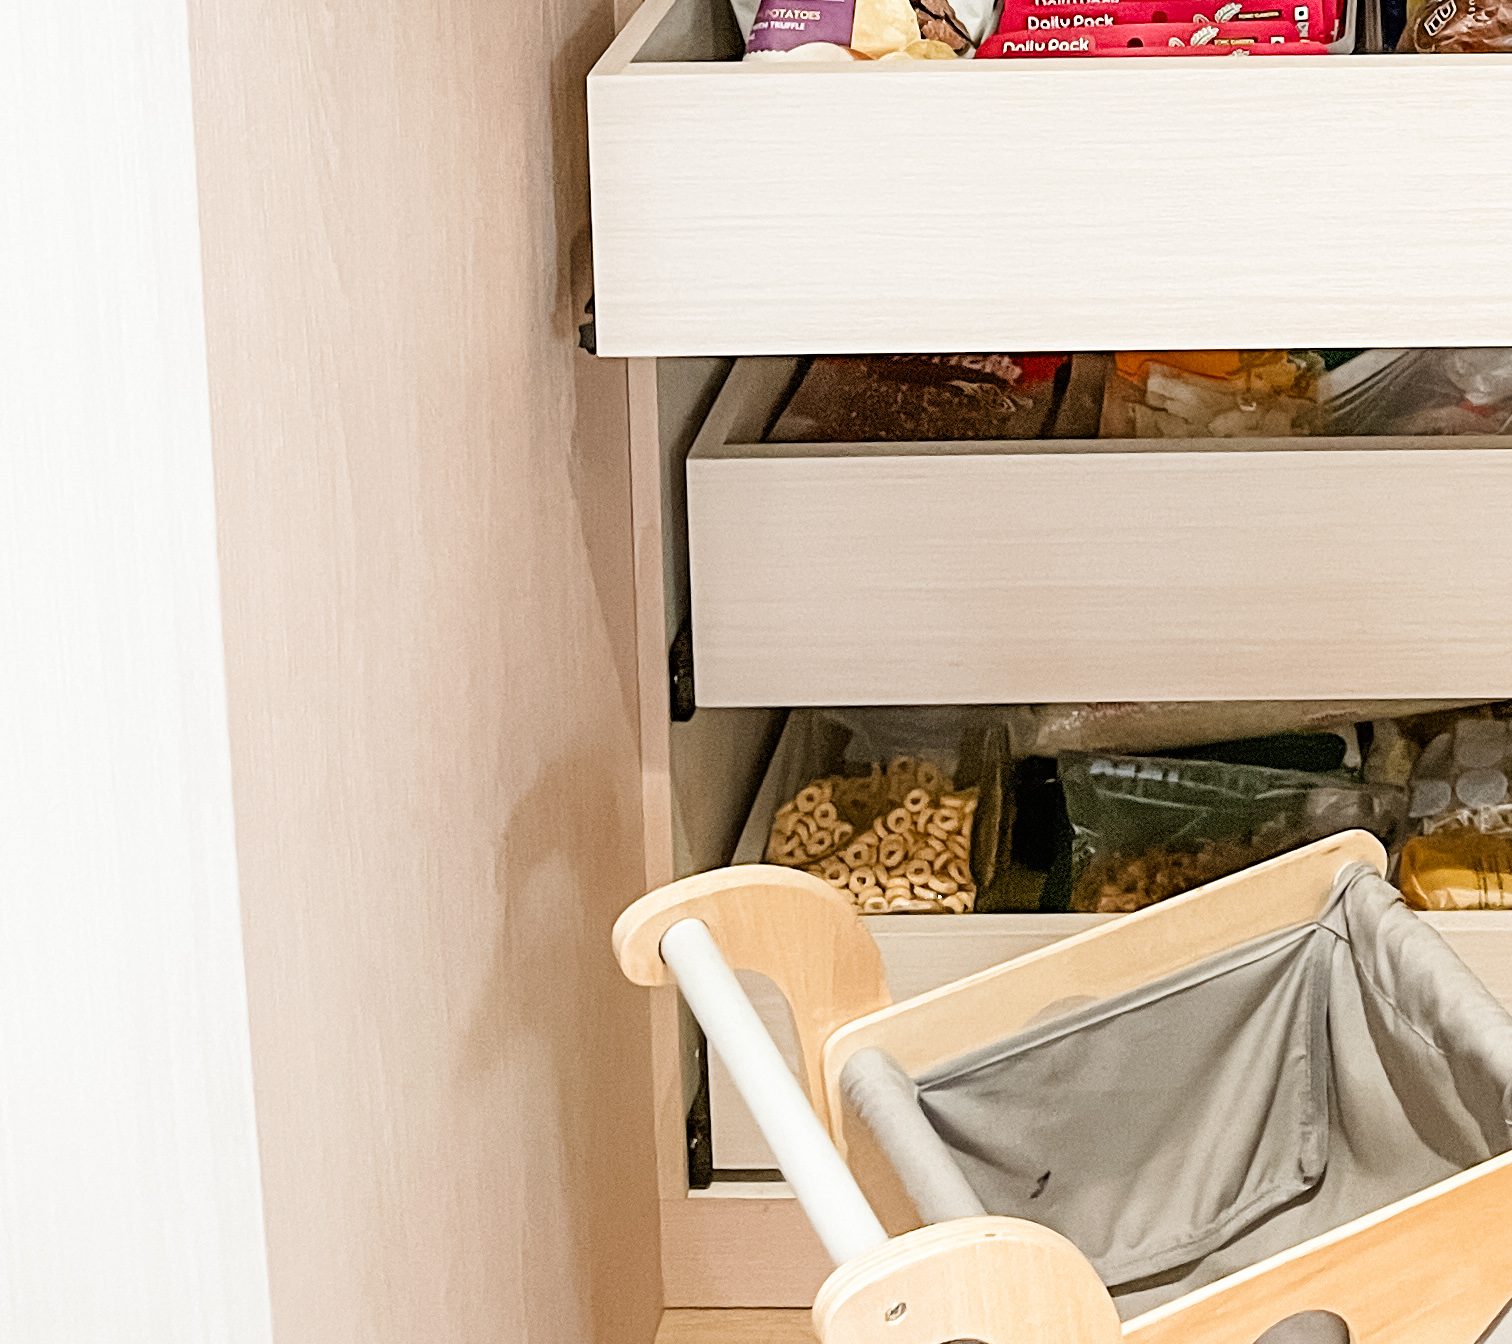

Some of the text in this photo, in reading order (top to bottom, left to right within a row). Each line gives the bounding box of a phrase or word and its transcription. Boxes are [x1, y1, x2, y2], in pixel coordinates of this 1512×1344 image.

[764, 8, 821, 21] OTATOES
[1073, 13, 1114, 28] Pack
[769, 20, 805, 31] TRUFFLE
[1048, 37, 1090, 52] Pack
